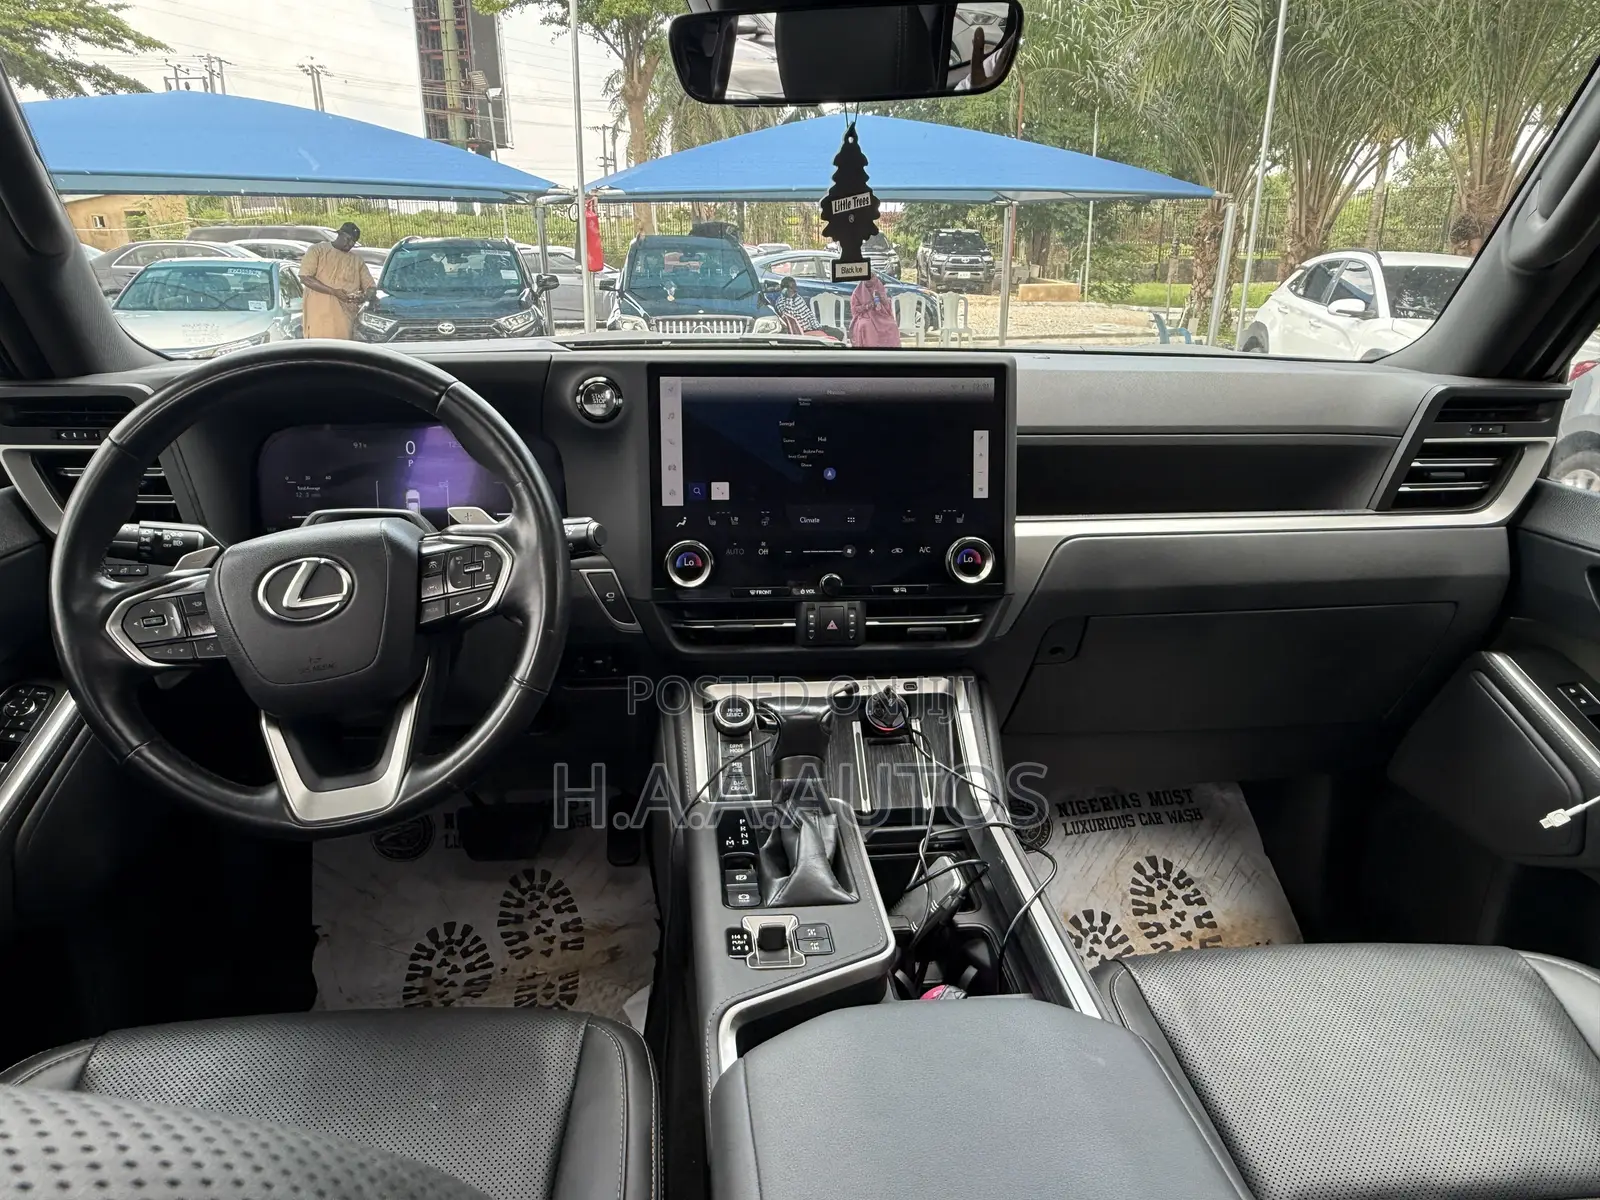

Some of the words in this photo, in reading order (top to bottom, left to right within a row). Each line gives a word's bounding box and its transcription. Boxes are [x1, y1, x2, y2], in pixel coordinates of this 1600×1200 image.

[834, 198, 851, 213] Little
[852, 195, 870, 208] Trees
[841, 266, 855, 275] Black
[855, 265, 863, 273] Ice
[405, 440, 416, 455] 0
[408, 459, 414, 467] P
[800, 516, 820, 524] Climate
[683, 557, 695, 566] Lo
[963, 554, 974, 563] Lo
[1055, 793, 1142, 817] NIGERIAS
[1146, 788, 1194, 806] MOST
[1062, 814, 1136, 836] LUXURIOUS
[1137, 812, 1164, 826] CAR
[1165, 808, 1203, 824] WASH
